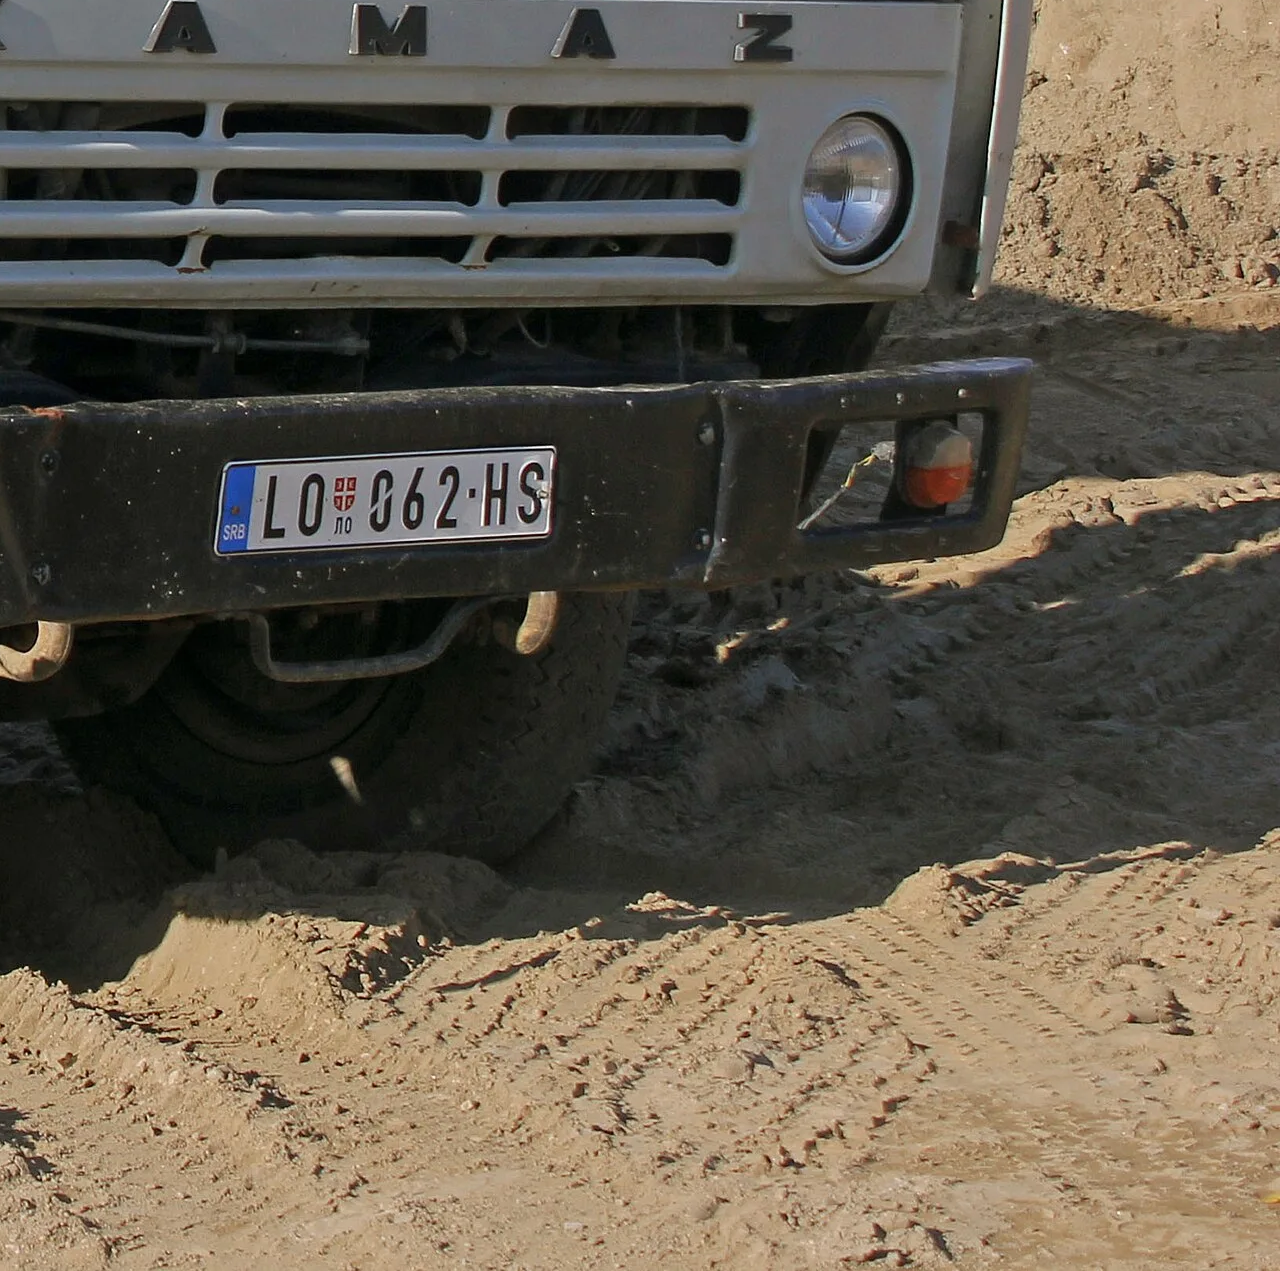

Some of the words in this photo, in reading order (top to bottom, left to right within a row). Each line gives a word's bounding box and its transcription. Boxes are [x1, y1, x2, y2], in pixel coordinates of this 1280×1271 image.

[262, 472, 325, 540] LO
[223, 524, 245, 541] SRB
[333, 515, 352, 535] ЛО
